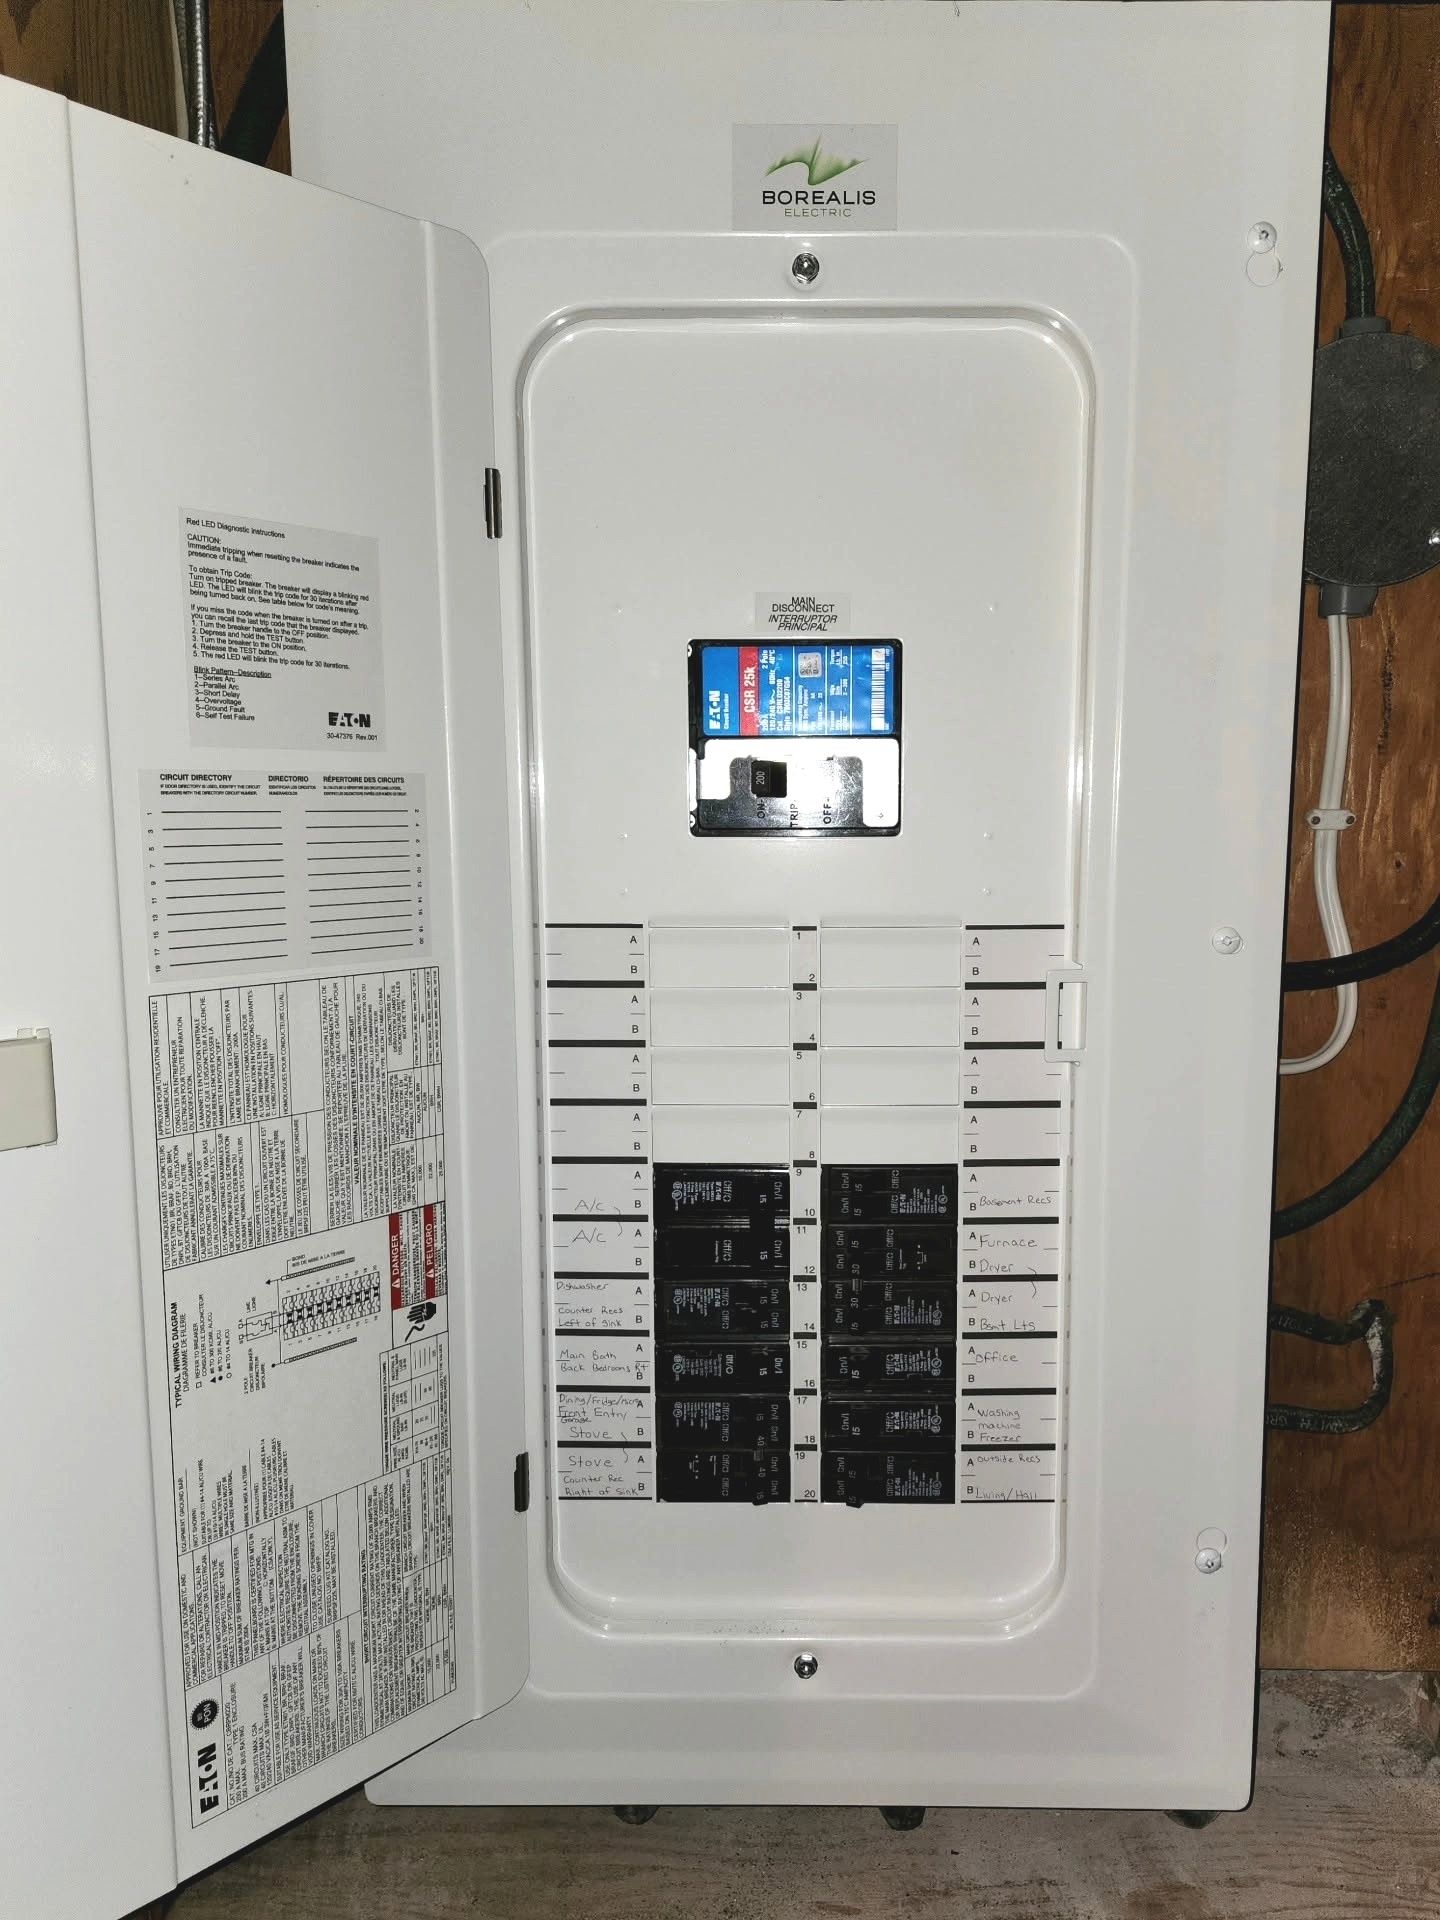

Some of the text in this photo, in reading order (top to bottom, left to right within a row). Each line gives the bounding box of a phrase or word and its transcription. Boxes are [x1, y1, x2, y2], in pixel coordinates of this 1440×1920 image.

[762, 190, 876, 205] BOREALIS
[784, 208, 852, 218] ELECTRIC
[186, 518, 199, 526] Red
[201, 520, 215, 528] LED
[217, 522, 249, 533] Diagnostic
[187, 533, 221, 544] CAUTION:
[188, 541, 220, 552] Immediate
[222, 546, 245, 556] tripping
[264, 553, 290, 563] resetting
[302, 557, 323, 566] breaker
[325, 560, 349, 570] indicates
[220, 568, 232, 578] Trip
[234, 570, 252, 579] Code:
[792, 597, 816, 605] MAIN
[772, 604, 835, 613] DISCONNECT
[768, 614, 838, 624] INTERRUPTOR
[778, 622, 828, 632] PRINCIPAL
[222, 691, 240, 699] Delay
[744, 668, 756, 713] CSR 25k
[709, 690, 720, 730] EATON
[328, 712, 370, 728] EATON
[323, 774, 362, 783] RÉPERTOIRE
[756, 771, 765, 785] 200
[790, 804, 798, 827] TRIP
[796, 932, 800, 940] 1
[808, 974, 816, 982] 2
[796, 992, 802, 1000] 3
[808, 1034, 816, 1042] 4
[796, 1052, 802, 1060] 5
[351, 1068, 356, 1077] EN
[808, 1092, 816, 1100] 6
[796, 1110, 802, 1118] 7
[808, 1150, 814, 1158] 8
[634, 1170, 642, 1180] A
[796, 1168, 802, 1176] 9
[970, 1174, 976, 1182] A
[760, 1194, 767, 1204] 15
[634, 1200, 642, 1208] B
[970, 1202, 976, 1212] B
[804, 1208, 816, 1216] 10
[634, 1228, 642, 1238] A
[796, 1226, 806, 1234] 11
[968, 1232, 976, 1240] A
[980, 1234, 1038, 1248] Furnace
[391, 1233, 400, 1276] DANGER
[760, 1251, 768, 1260] 15
[634, 1258, 642, 1266] B
[968, 1260, 976, 1268] B
[980, 1258, 1014, 1273] Dryer
[804, 1266, 816, 1274] 12
[636, 1286, 642, 1294] A
[796, 1282, 808, 1292] 13
[968, 1288, 976, 1298] A
[981, 1292, 1012, 1304] Dryer
[171, 1302, 179, 1340] DIAGRAM
[558, 1318, 580, 1327] Left
[585, 1317, 596, 1327] of
[636, 1314, 642, 1324] B
[968, 1318, 976, 1326] B
[804, 1322, 814, 1330] 14
[636, 1344, 644, 1352] A
[796, 1340, 808, 1348] 15
[560, 1349, 616, 1360] Main Bath
[968, 1346, 976, 1354] A
[172, 1342, 180, 1372] WIRING
[976, 1351, 1018, 1363] Office
[560, 1363, 584, 1372] Back
[636, 1372, 644, 1380] B
[968, 1374, 974, 1382] B
[804, 1380, 816, 1388] 16
[796, 1396, 808, 1404] 17
[594, 1407, 627, 1421] Entry
[978, 1408, 1020, 1420] Washing
[570, 1426, 612, 1439] Stove
[804, 1436, 816, 1444] 18
[980, 1433, 1020, 1442] Freezer
[796, 1452, 806, 1460] 19
[569, 1456, 613, 1468] Stove
[599, 1487, 610, 1496] of
[804, 1490, 816, 1498] 20
[198, 1742, 219, 1814] EATON
